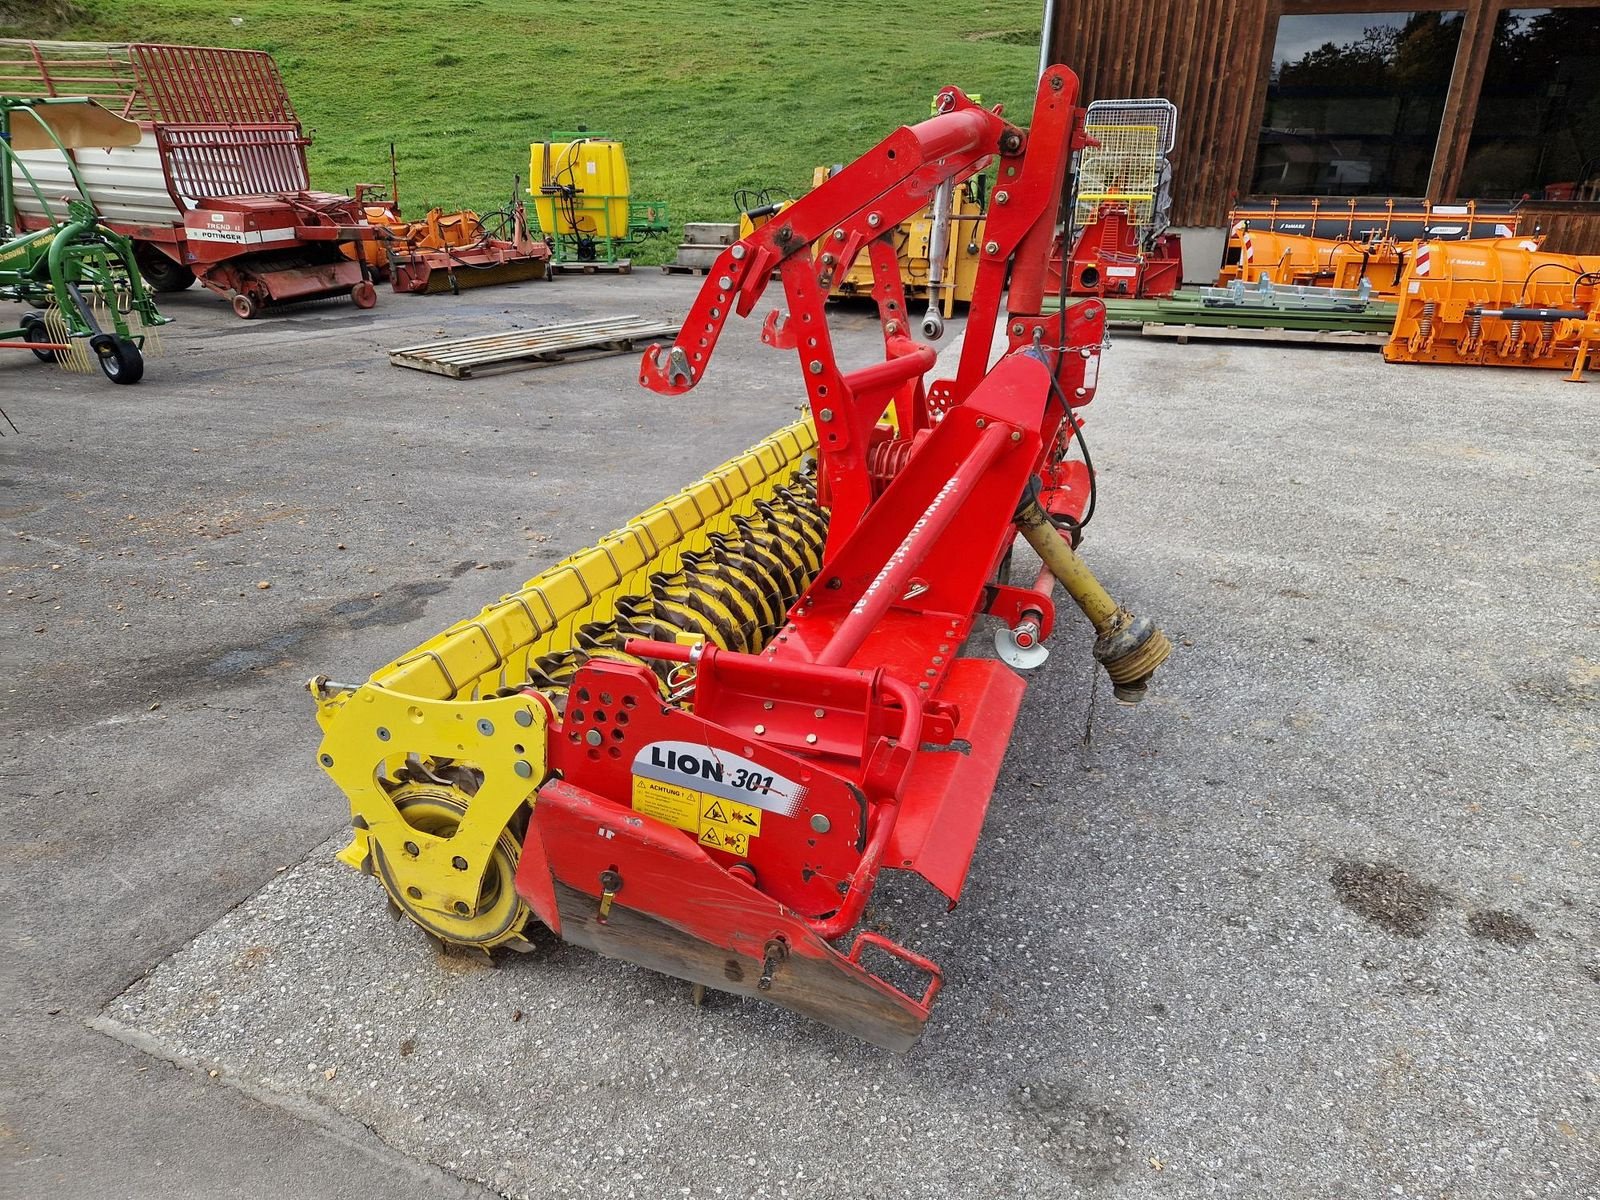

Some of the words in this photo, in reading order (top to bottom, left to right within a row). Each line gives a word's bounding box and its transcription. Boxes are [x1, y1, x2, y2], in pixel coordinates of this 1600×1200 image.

[207, 222, 231, 230] TREND
[652, 746, 724, 783] LION
[731, 768, 775, 796] 301
[649, 784, 680, 796] ACHTUNG
